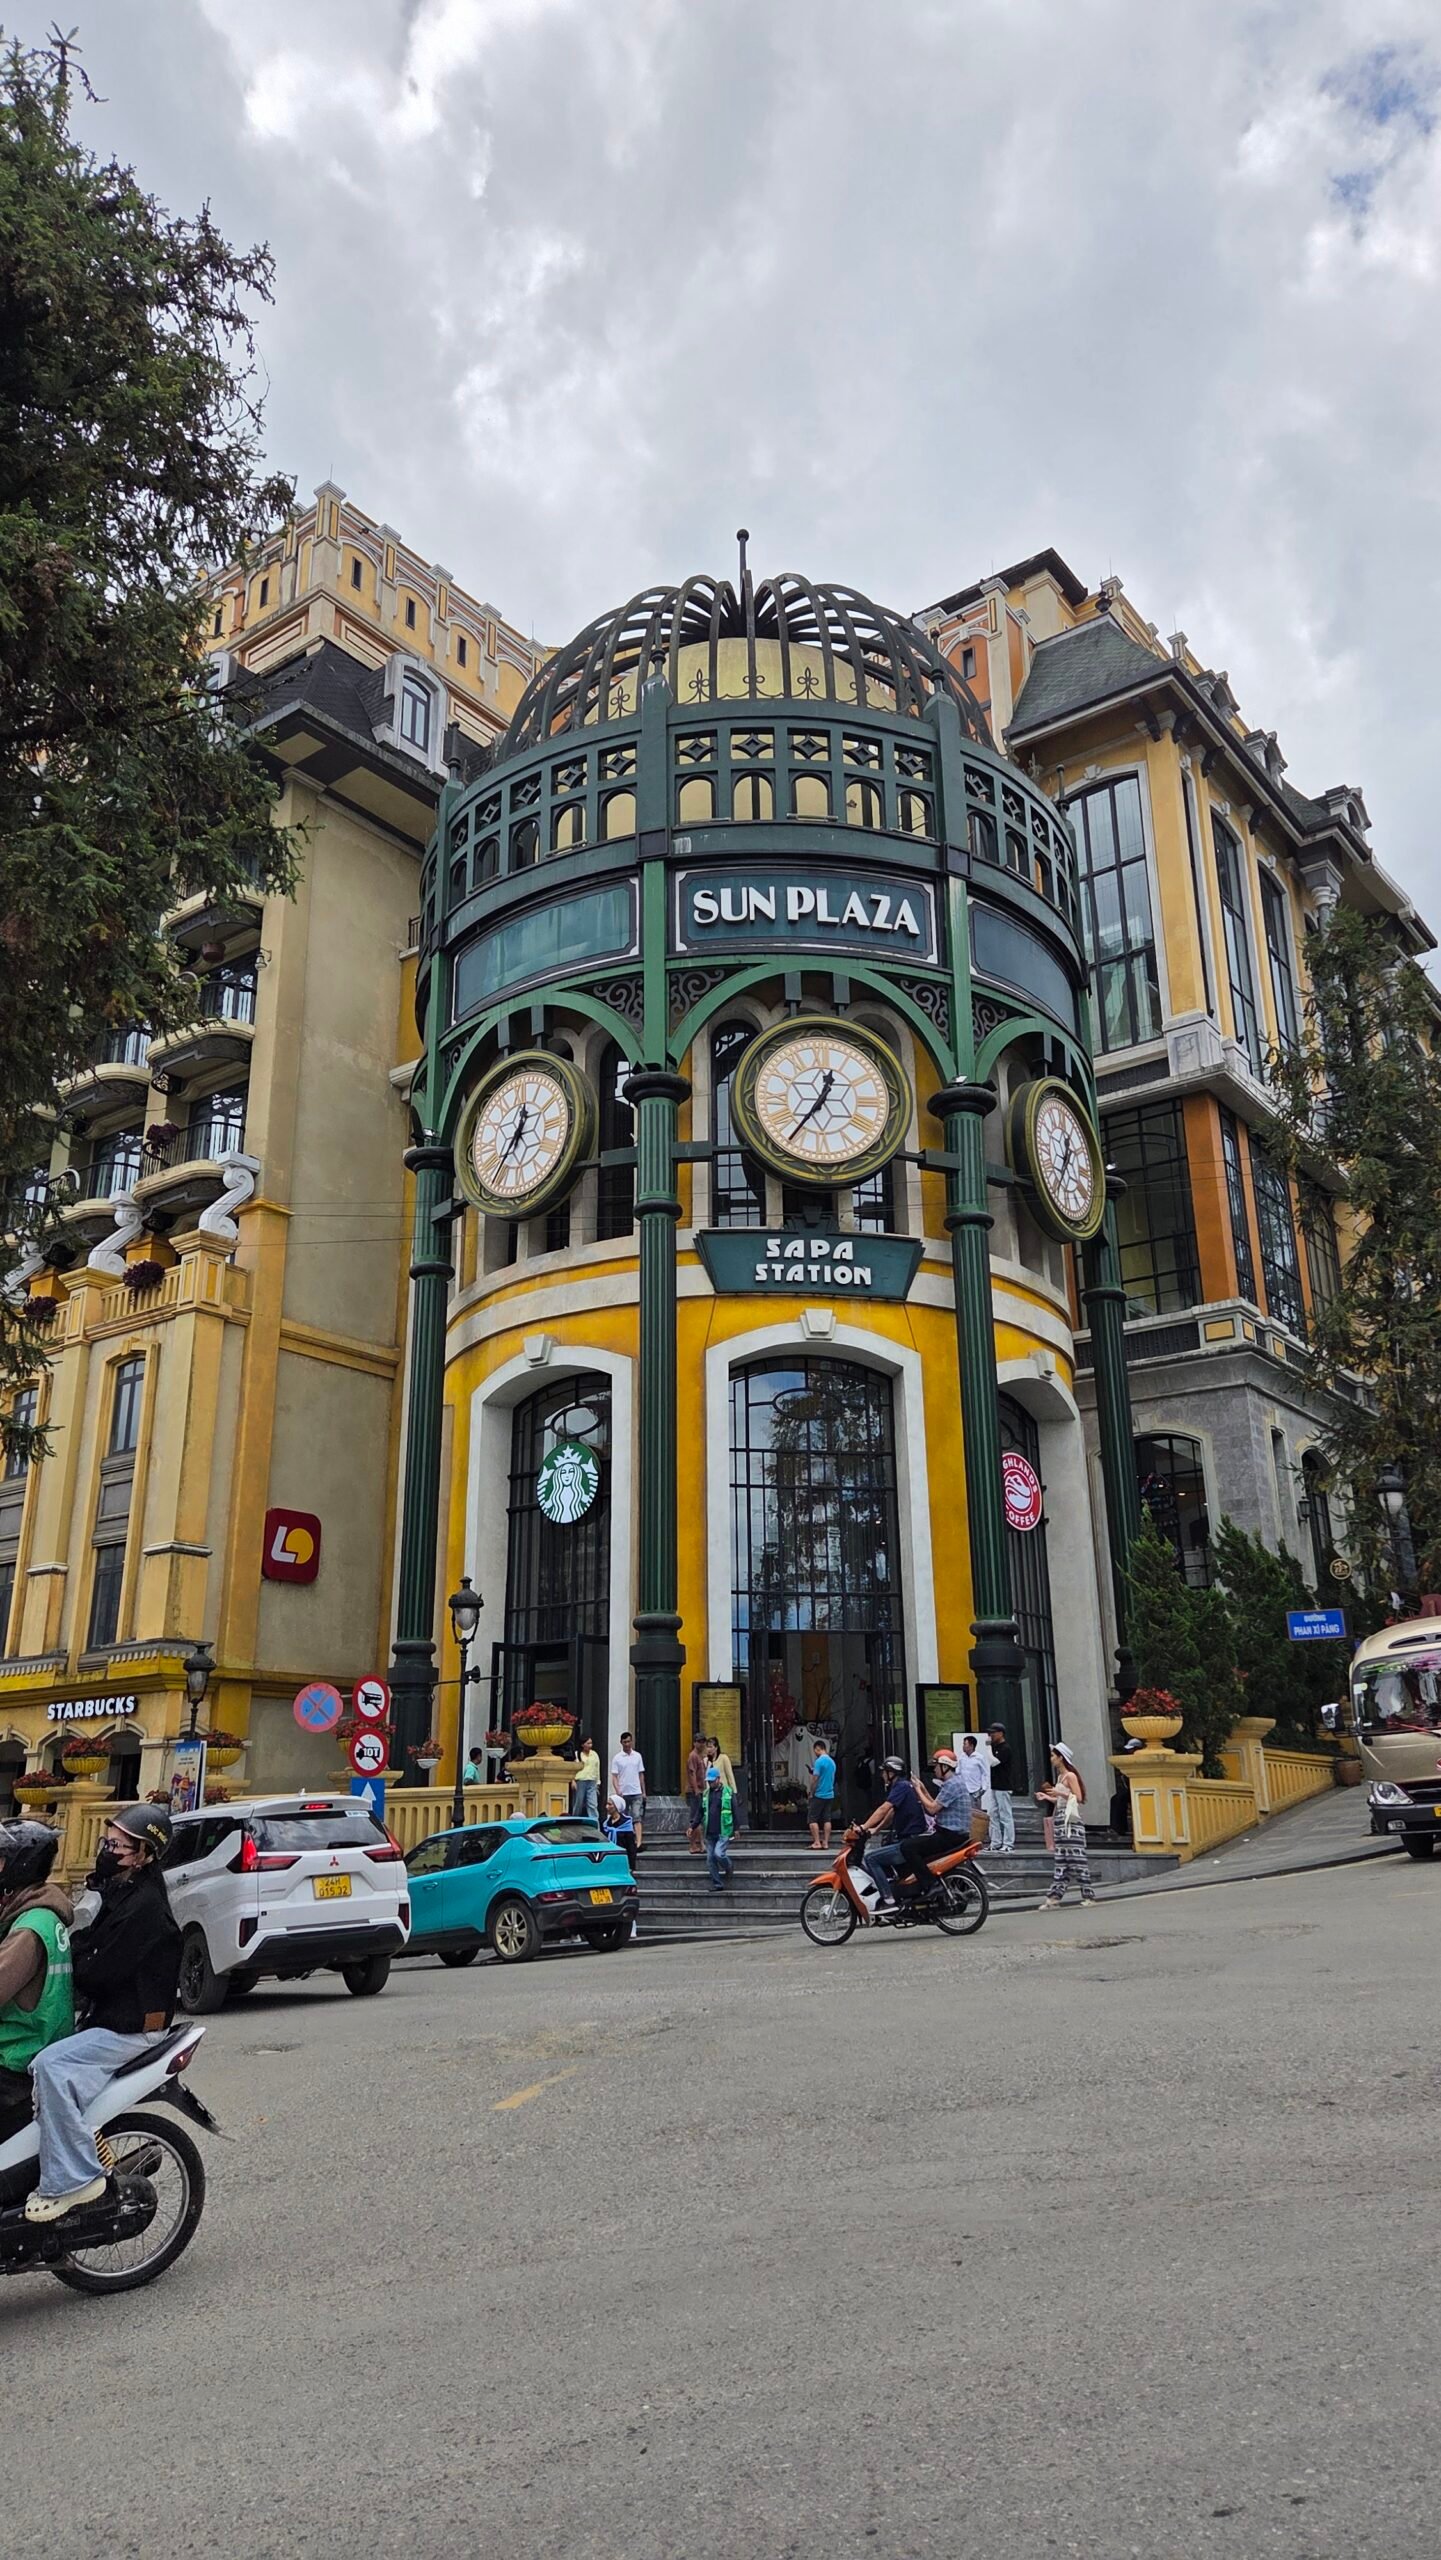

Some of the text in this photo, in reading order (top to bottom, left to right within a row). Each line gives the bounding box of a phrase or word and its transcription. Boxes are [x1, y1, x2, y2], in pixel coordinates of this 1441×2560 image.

[693, 886, 921, 936] SUN PLAZA
[766, 1238, 854, 1260] SAPA
[755, 1264, 872, 1286] STATION
[1002, 1457, 1038, 1493] GHLANDS
[1293, 1625, 1312, 1637] PHAN
[47, 1696, 135, 1720] STARBUCKS
